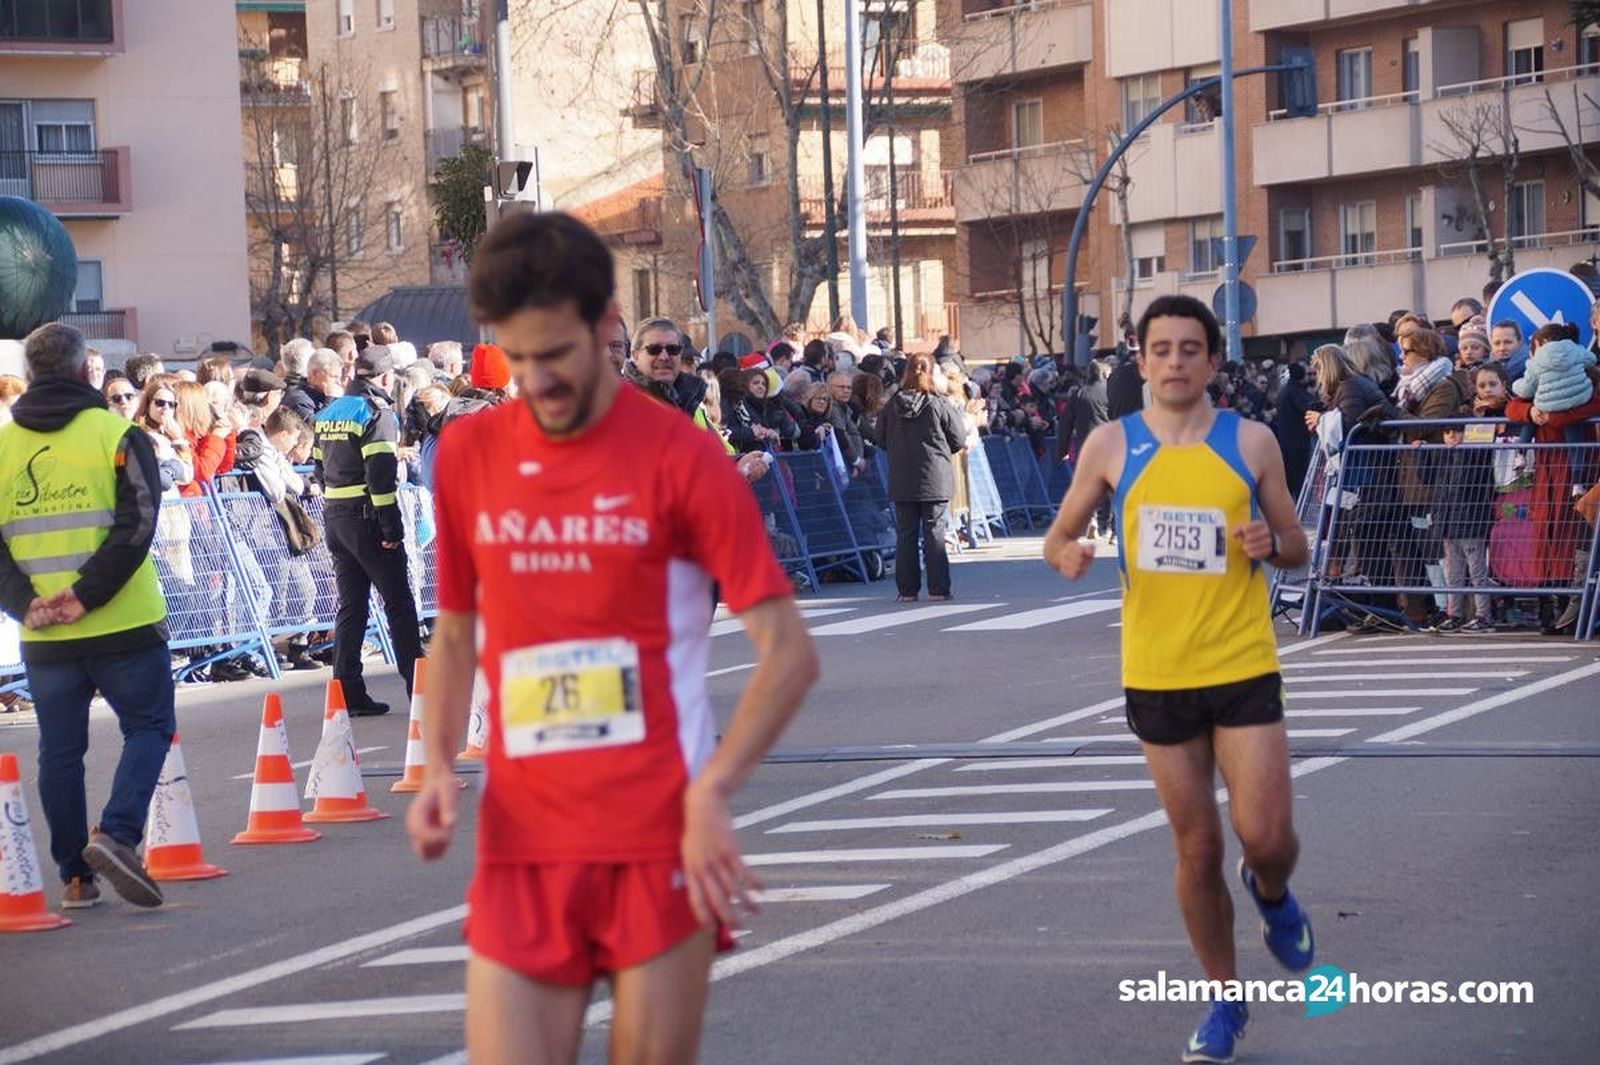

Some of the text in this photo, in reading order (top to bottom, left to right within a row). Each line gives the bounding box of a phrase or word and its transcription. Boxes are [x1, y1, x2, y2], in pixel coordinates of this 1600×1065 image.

[1153, 523, 1201, 551] 2153
[510, 551, 593, 574] RIOJA
[540, 673, 581, 714] 26
